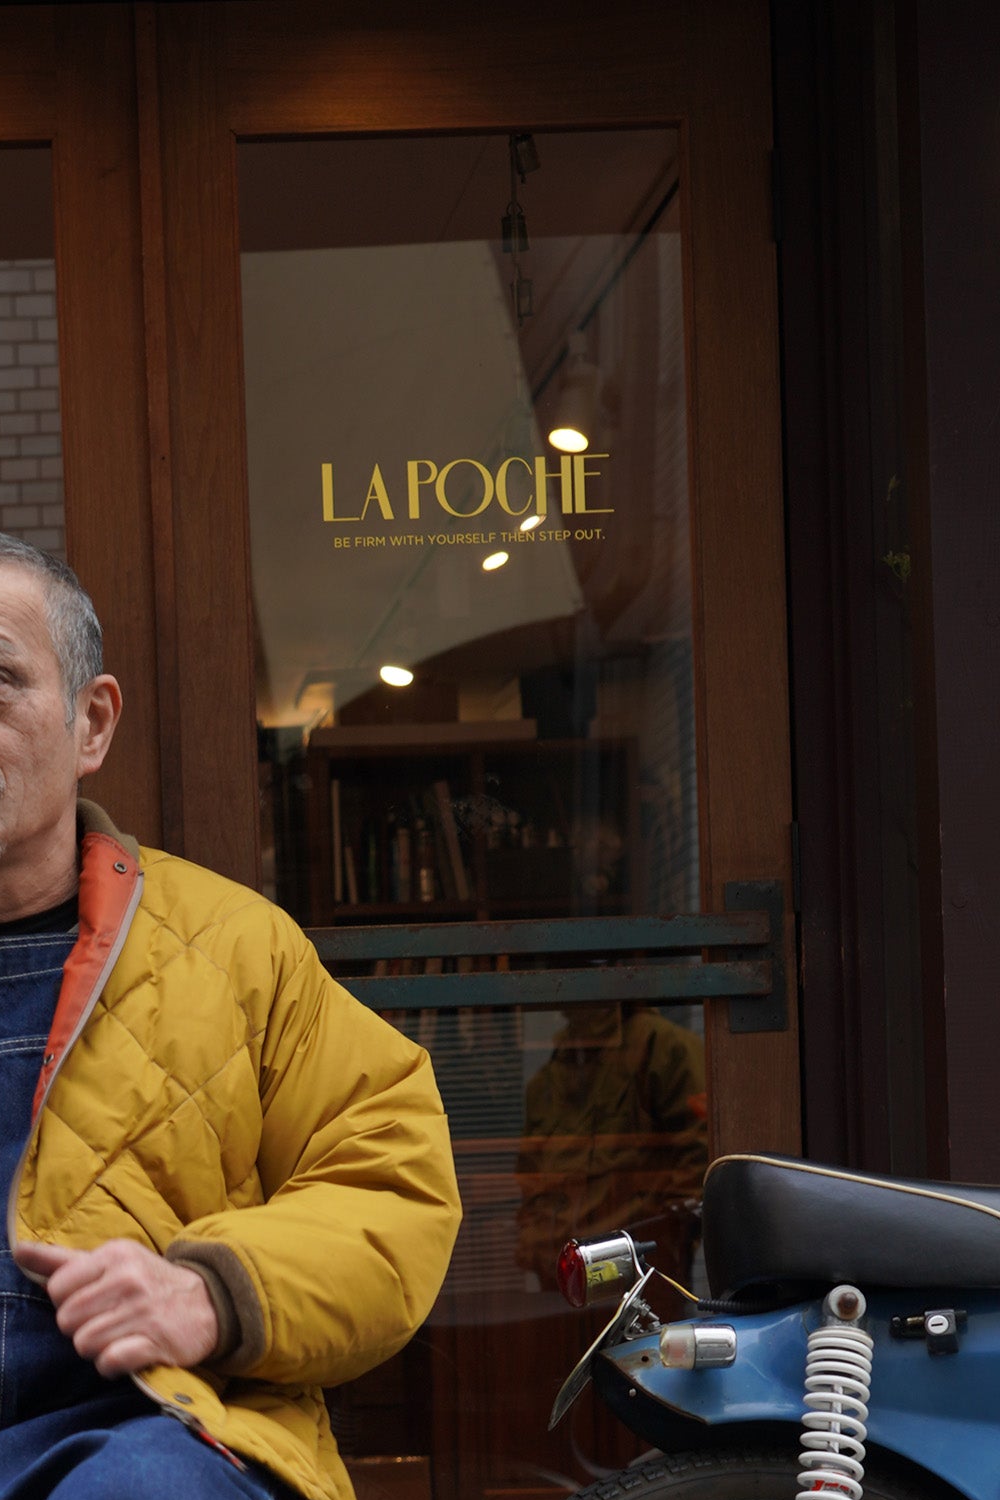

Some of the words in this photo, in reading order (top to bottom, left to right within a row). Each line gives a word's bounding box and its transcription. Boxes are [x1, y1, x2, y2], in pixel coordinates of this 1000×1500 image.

[321, 463, 395, 522] LA
[407, 454, 615, 520] POCHE
[334, 536, 351, 549] BE
[354, 536, 386, 548] FIRM
[389, 535, 424, 546] WITH
[427, 532, 497, 545] YOURSELF
[500, 531, 535, 543] THEN
[539, 530, 571, 542] STEP
[574, 528, 606, 540] OUT.
